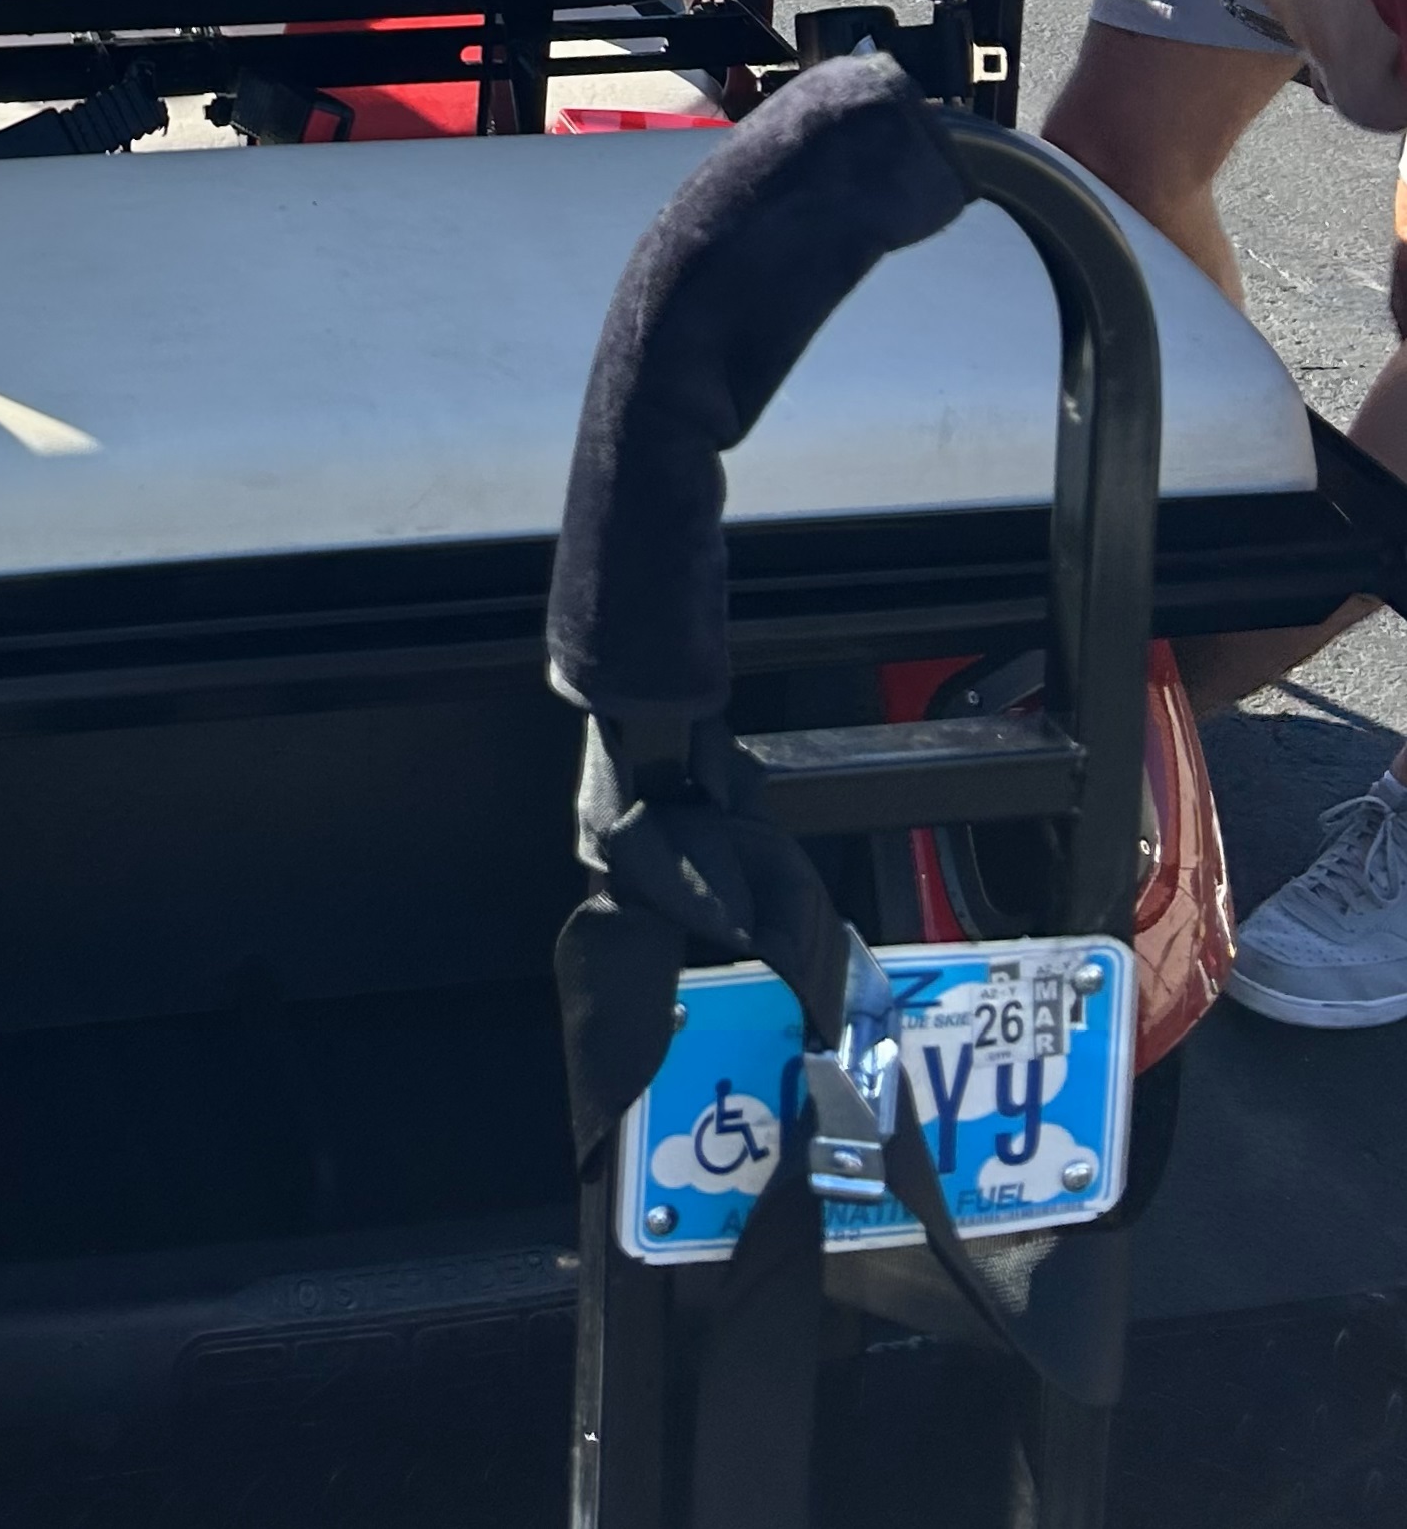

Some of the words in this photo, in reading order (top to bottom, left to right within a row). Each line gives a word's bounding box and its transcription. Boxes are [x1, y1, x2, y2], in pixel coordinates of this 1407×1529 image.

[934, 1012, 972, 1028] SKIE
[974, 998, 1024, 1049] 26
[1035, 980, 1058, 1055] MAR
[956, 1181, 1033, 1215] FUEL
